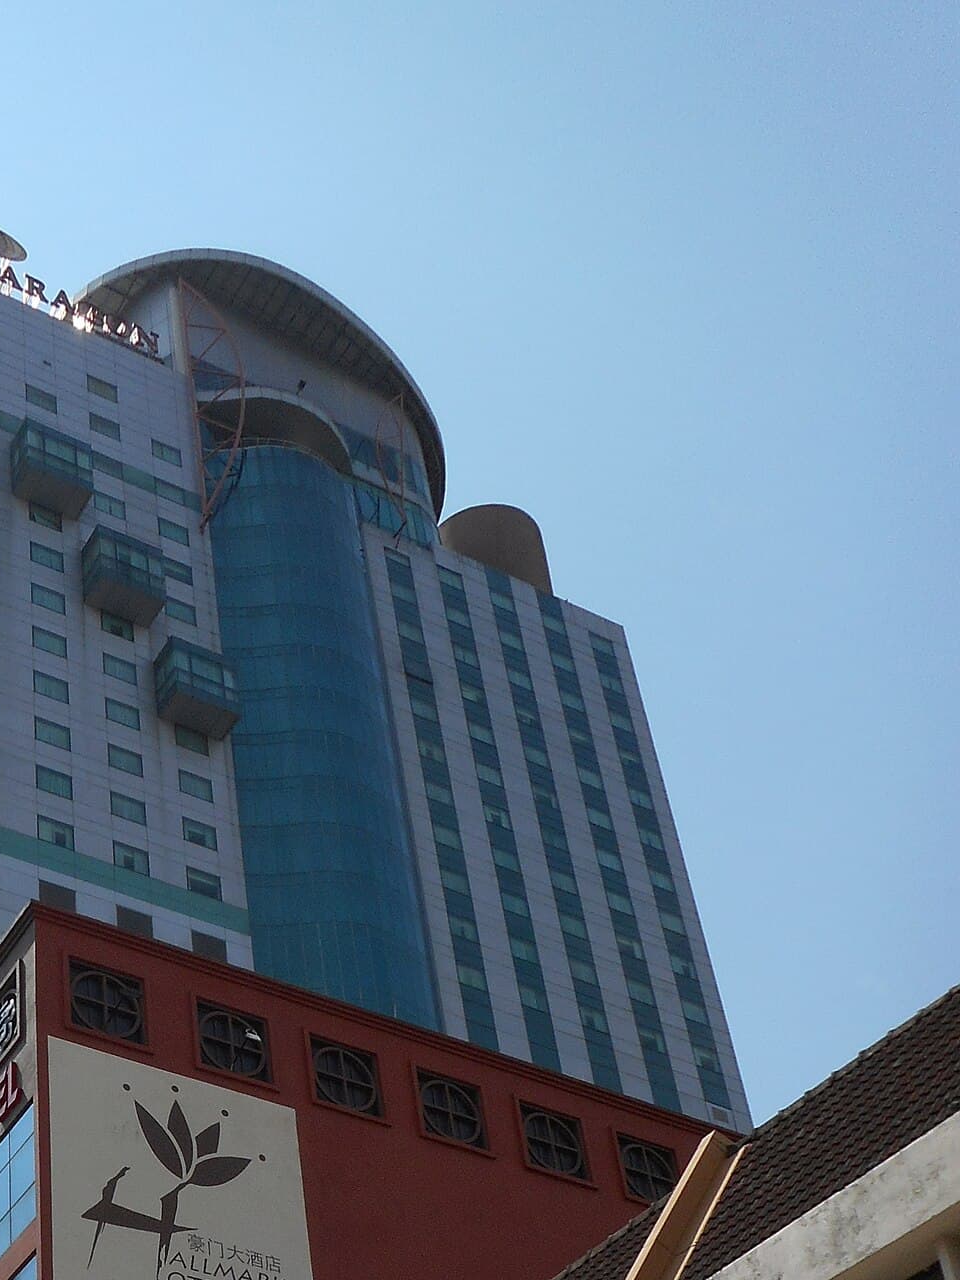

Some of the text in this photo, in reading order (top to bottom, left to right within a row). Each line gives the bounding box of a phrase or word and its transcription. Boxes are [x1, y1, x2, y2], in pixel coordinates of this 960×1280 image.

[187, 1232, 281, 1274] 豪门大酒店
